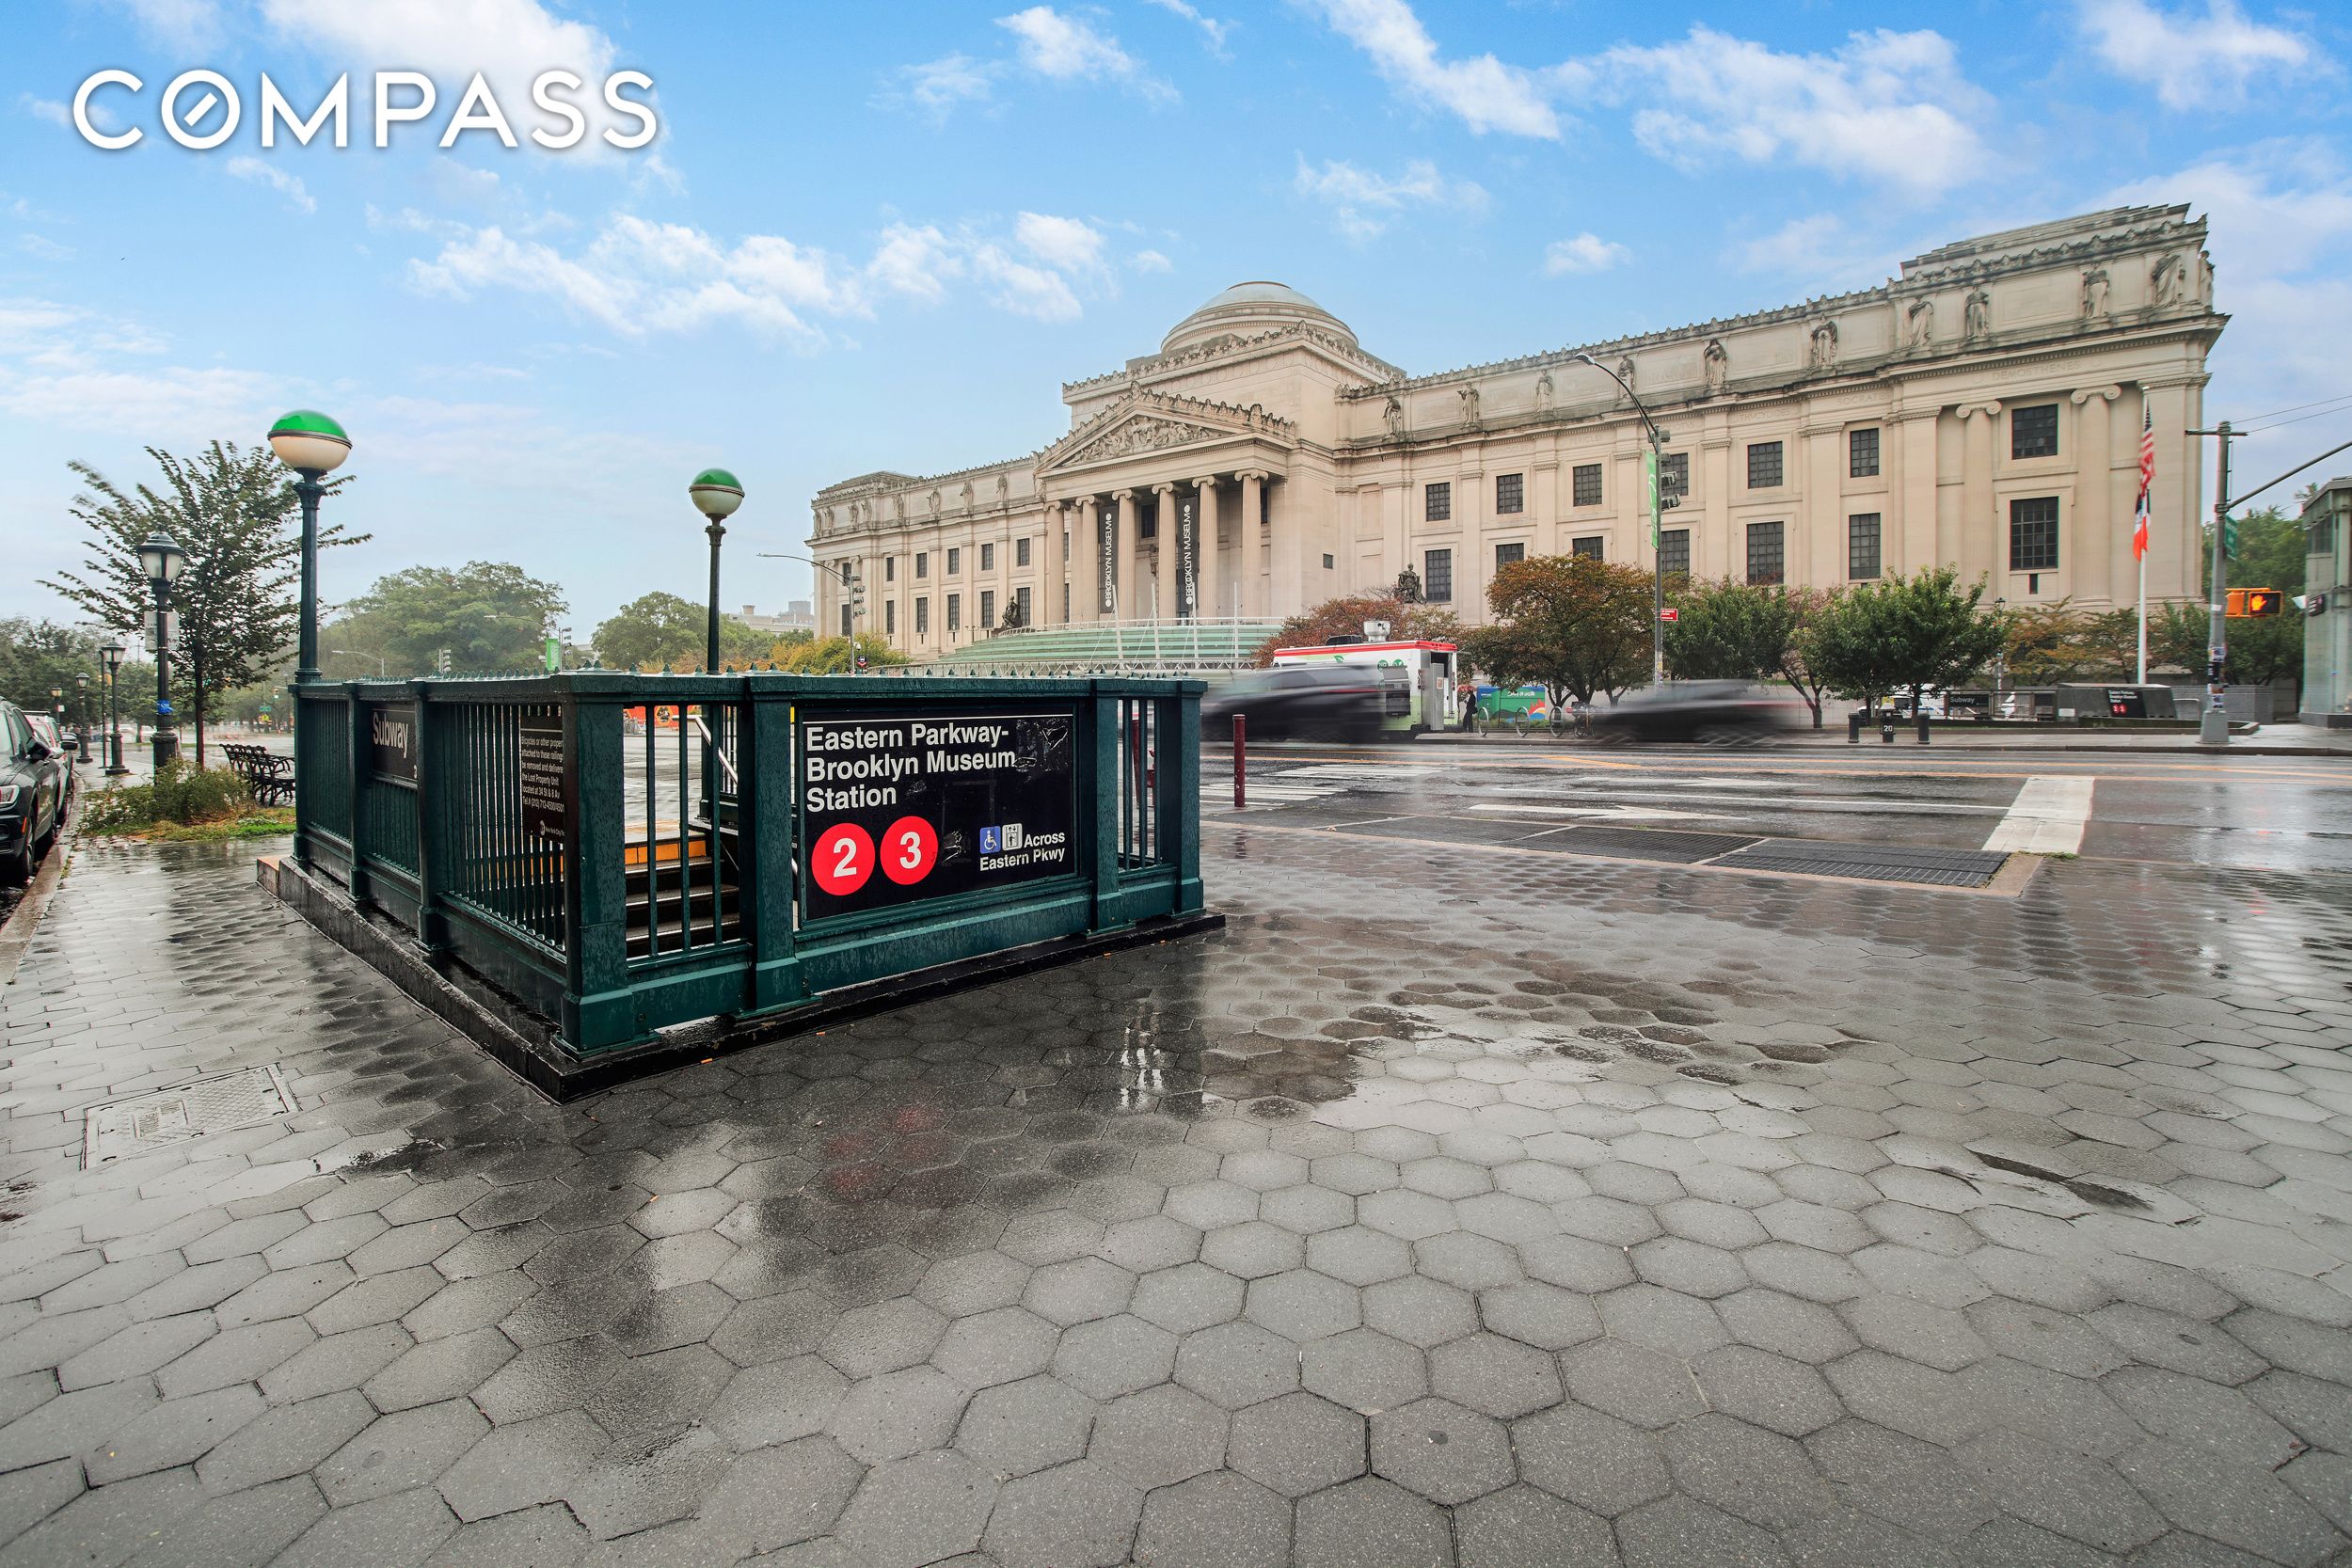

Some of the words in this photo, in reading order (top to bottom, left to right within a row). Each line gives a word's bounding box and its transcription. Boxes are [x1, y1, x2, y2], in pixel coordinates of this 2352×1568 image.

[1184, 552, 1193, 596] BROOKLYN
[1949, 696, 1975, 705] Subway
[373, 711, 409, 758] Subway
[806, 726, 903, 752] Eastern
[911, 721, 1009, 748] Parkway-
[806, 753, 919, 782] Brooklyn
[927, 750, 1016, 773] Museum
[806, 784, 897, 813] Station
[833, 837, 857, 878] 2
[899, 831, 922, 869] 3
[1024, 832, 1065, 848] Across
[979, 853, 1030, 872] Eastern
[1032, 847, 1065, 863] Pkwy
